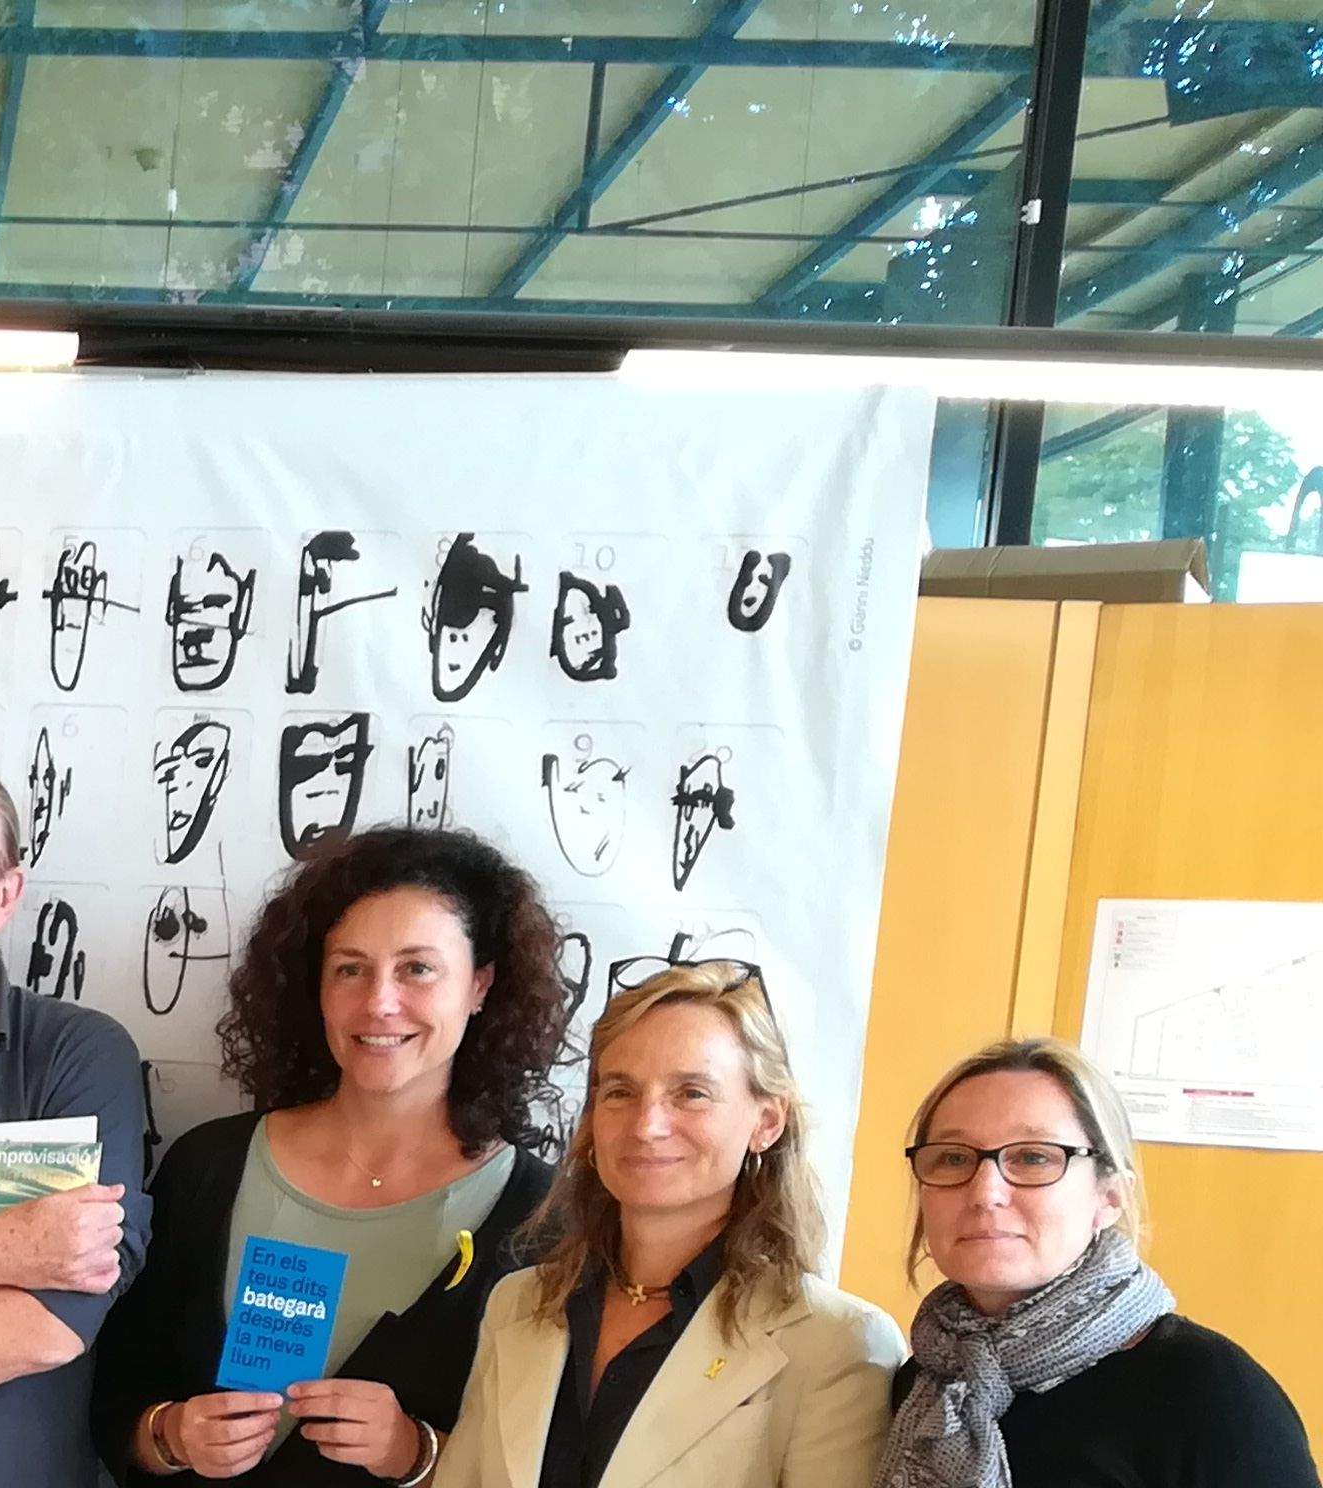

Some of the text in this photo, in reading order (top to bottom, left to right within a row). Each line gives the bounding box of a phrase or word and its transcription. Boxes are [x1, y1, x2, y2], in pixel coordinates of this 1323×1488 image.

[253, 1247, 308, 1273] En els
[248, 1269, 328, 1298] teus dits
[242, 1285, 326, 1319] bategarà
[239, 1310, 314, 1338] després
[236, 1327, 305, 1357] la meva
[230, 1347, 271, 1371] llum
